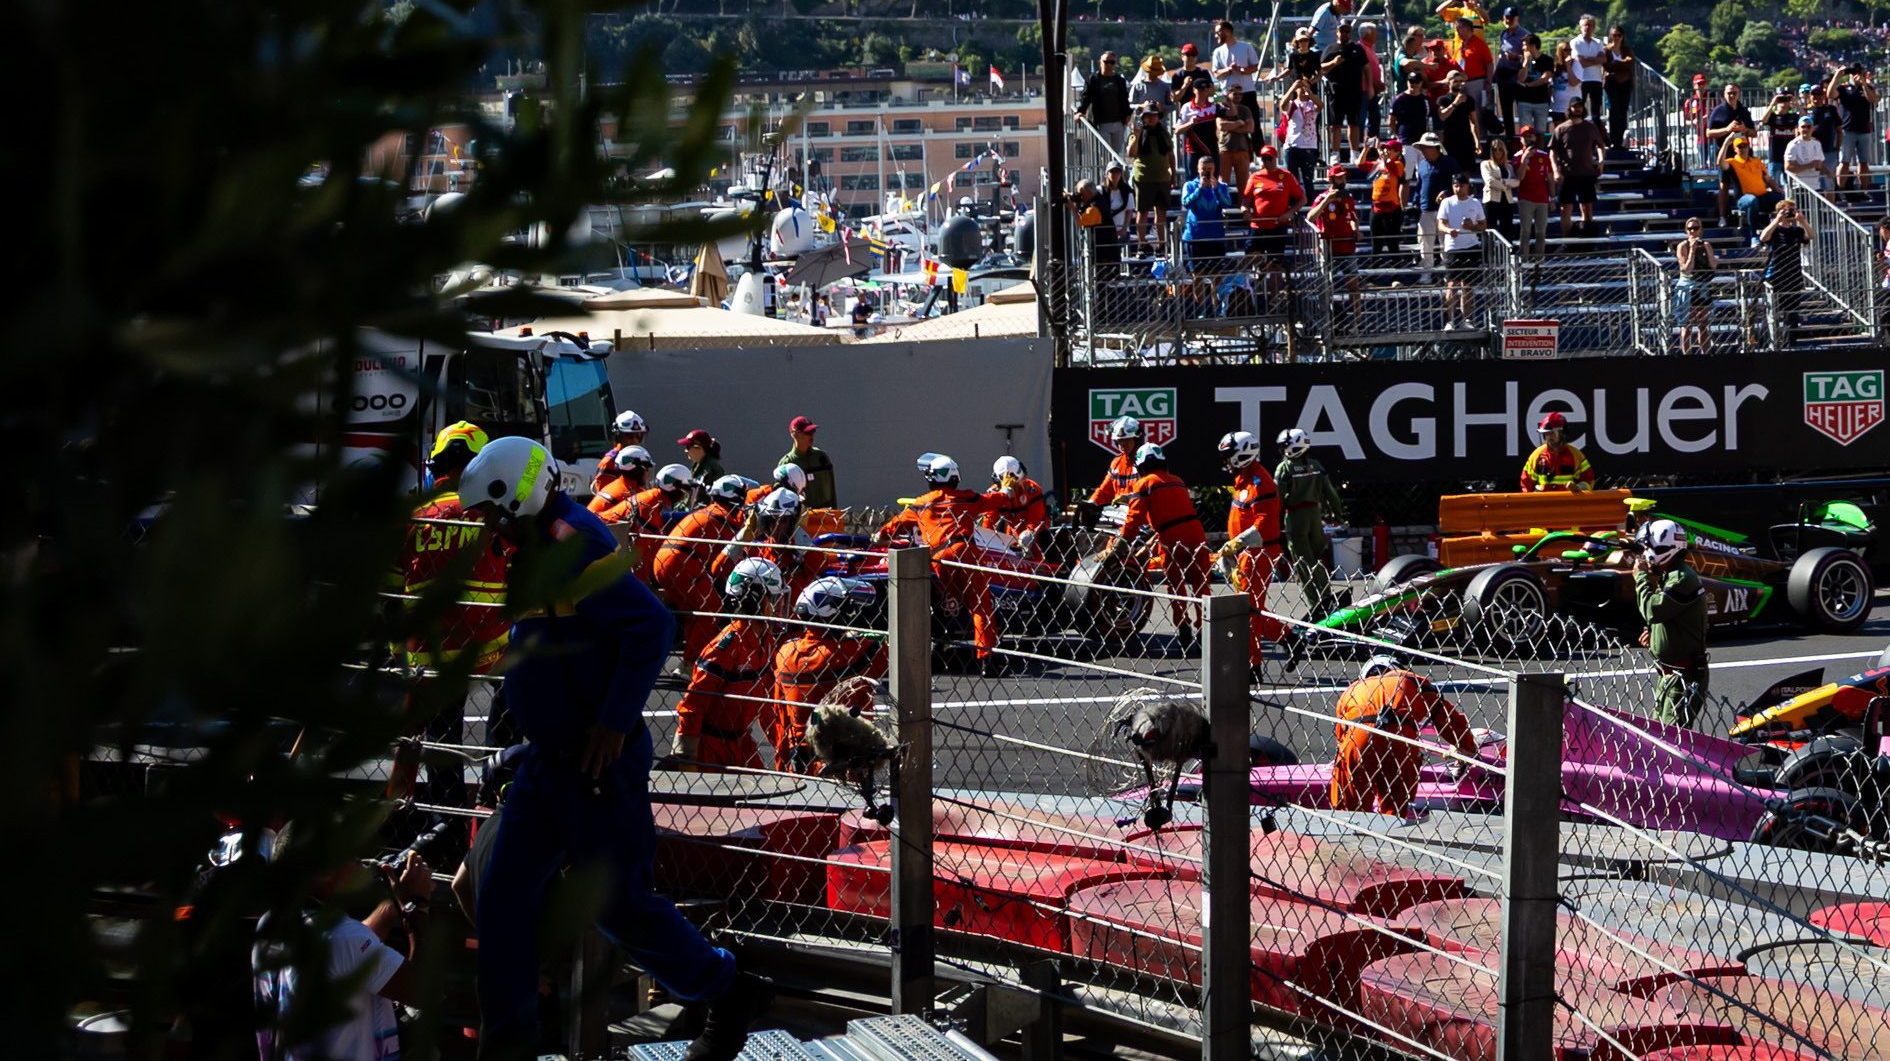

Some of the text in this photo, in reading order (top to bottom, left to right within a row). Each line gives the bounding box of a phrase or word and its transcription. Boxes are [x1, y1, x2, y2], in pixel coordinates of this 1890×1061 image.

[1507, 328, 1552, 336] SECTEUR 1
[1810, 372, 1879, 400] TAG
[1096, 392, 1169, 417] TAG
[1807, 402, 1882, 441] HEUER
[1093, 422, 1172, 449] HER
[1695, 536, 1740, 555] RACING
